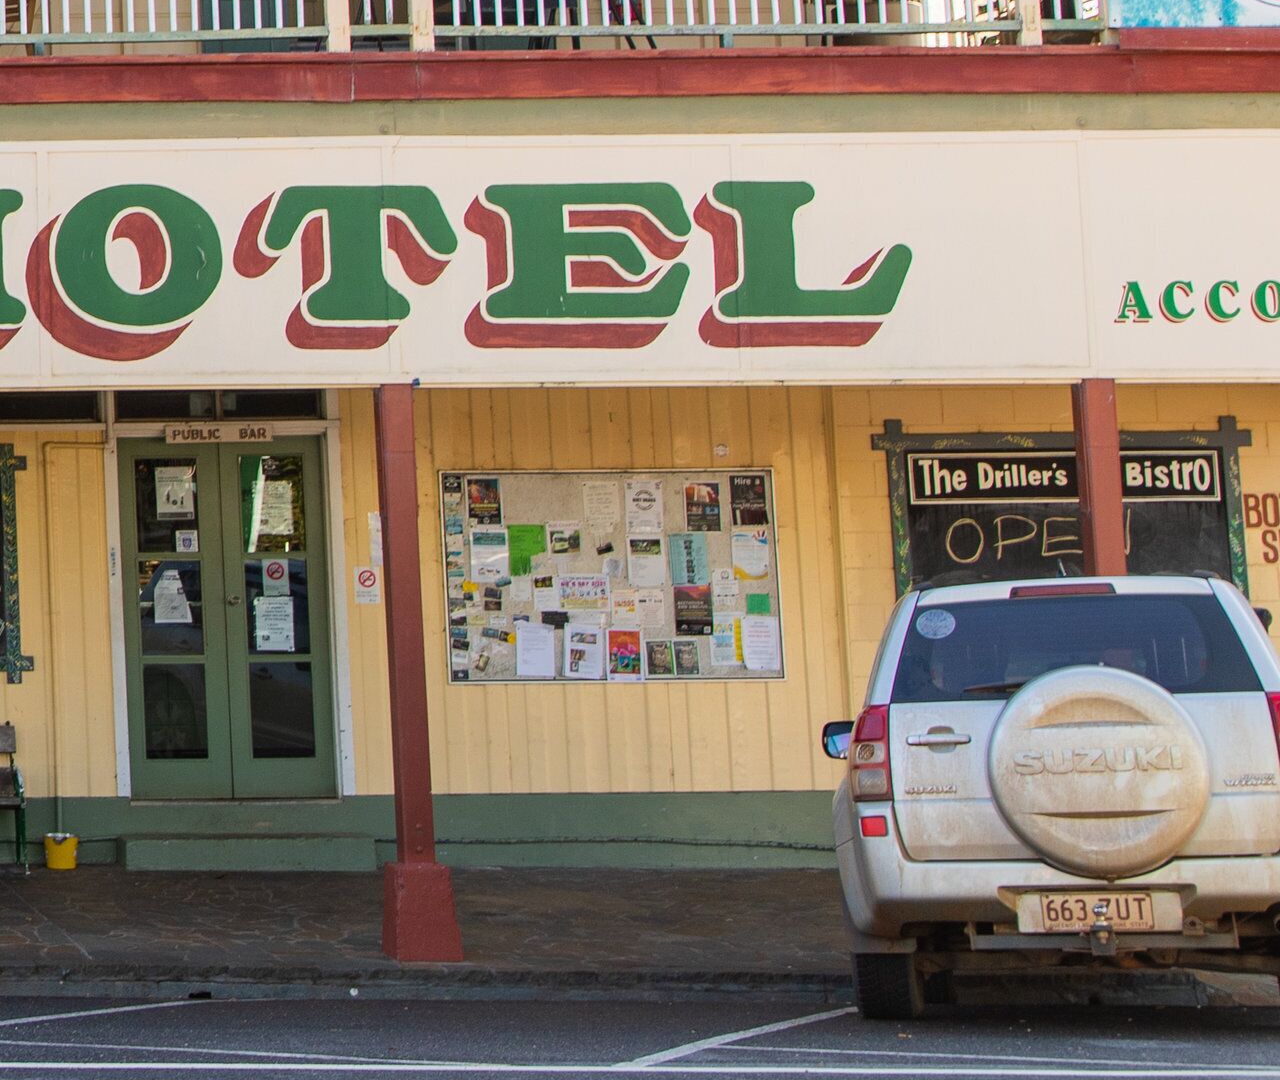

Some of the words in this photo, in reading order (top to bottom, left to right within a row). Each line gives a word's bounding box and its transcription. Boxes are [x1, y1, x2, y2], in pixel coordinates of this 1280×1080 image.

[172, 428, 220, 441] PUBLIC
[238, 427, 267, 439] BAR
[734, 476, 751, 486] Hire
[918, 459, 968, 496] The
[976, 462, 1069, 491] Driller's
[1013, 745, 1184, 776] SUZUKI
[904, 784, 958, 795] SUZUKI
[1046, 899, 1088, 922] 663
[1098, 897, 1146, 921] ZUT
